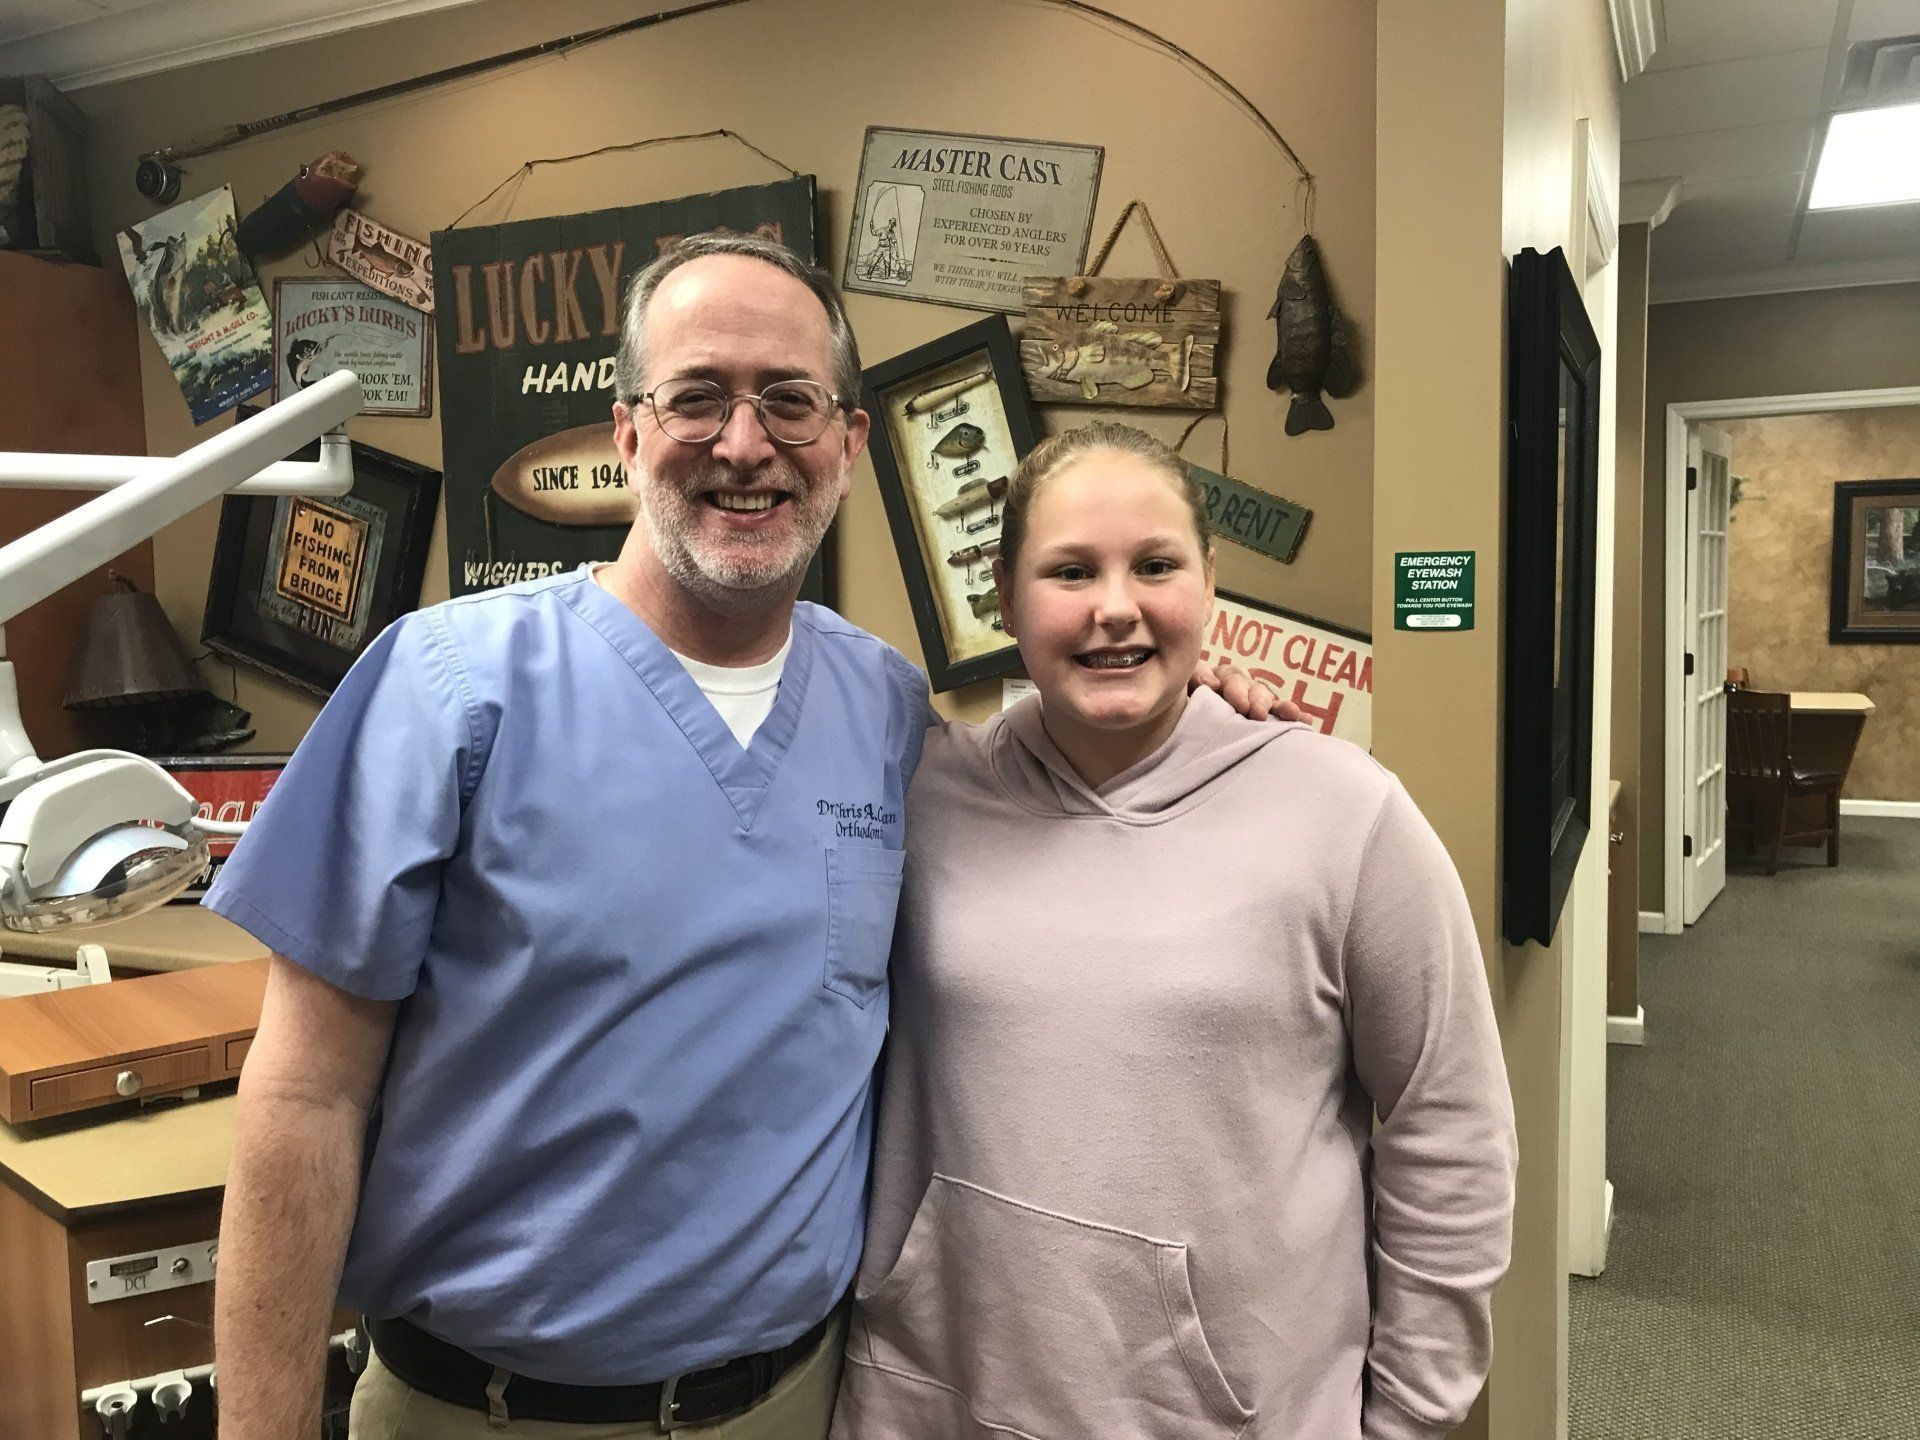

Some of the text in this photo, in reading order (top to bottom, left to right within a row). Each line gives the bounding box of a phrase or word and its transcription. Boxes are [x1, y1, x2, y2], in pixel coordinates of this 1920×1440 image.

[891, 148, 1063, 186] MASTER CAST
[932, 178, 1013, 199] STEEL FISHING RODS
[969, 207, 1033, 224] CHOSEN BY
[933, 217, 1067, 243] EXPERIENCED ANGLERS
[944, 233, 1050, 256] FOR OVER 50 YEARS
[345, 256, 414, 299] EXPEDITIONS
[935, 275, 957, 286] WITH
[959, 277, 985, 290] THEIR
[947, 264, 976, 276] THINK
[977, 268, 996, 278] YOU
[997, 271, 1018, 282] WILL
[311, 291, 329, 301] FISH
[453, 242, 625, 355] LUCKY
[284, 304, 355, 337] LUCKY'S
[1056, 301, 1176, 324] WELCOME
[533, 465, 579, 491] SINCE
[312, 517, 335, 539] NO
[1219, 495, 1290, 544] RENT
[293, 531, 352, 567] FISHING
[1400, 556, 1470, 566] EMERGENCY
[299, 554, 340, 584] FROM
[1407, 568, 1462, 578] EYEWASH
[290, 572, 343, 607] BRIDGE
[1411, 580, 1458, 590] STATION
[296, 605, 335, 640] FUN
[1209, 610, 1284, 662] NOT
